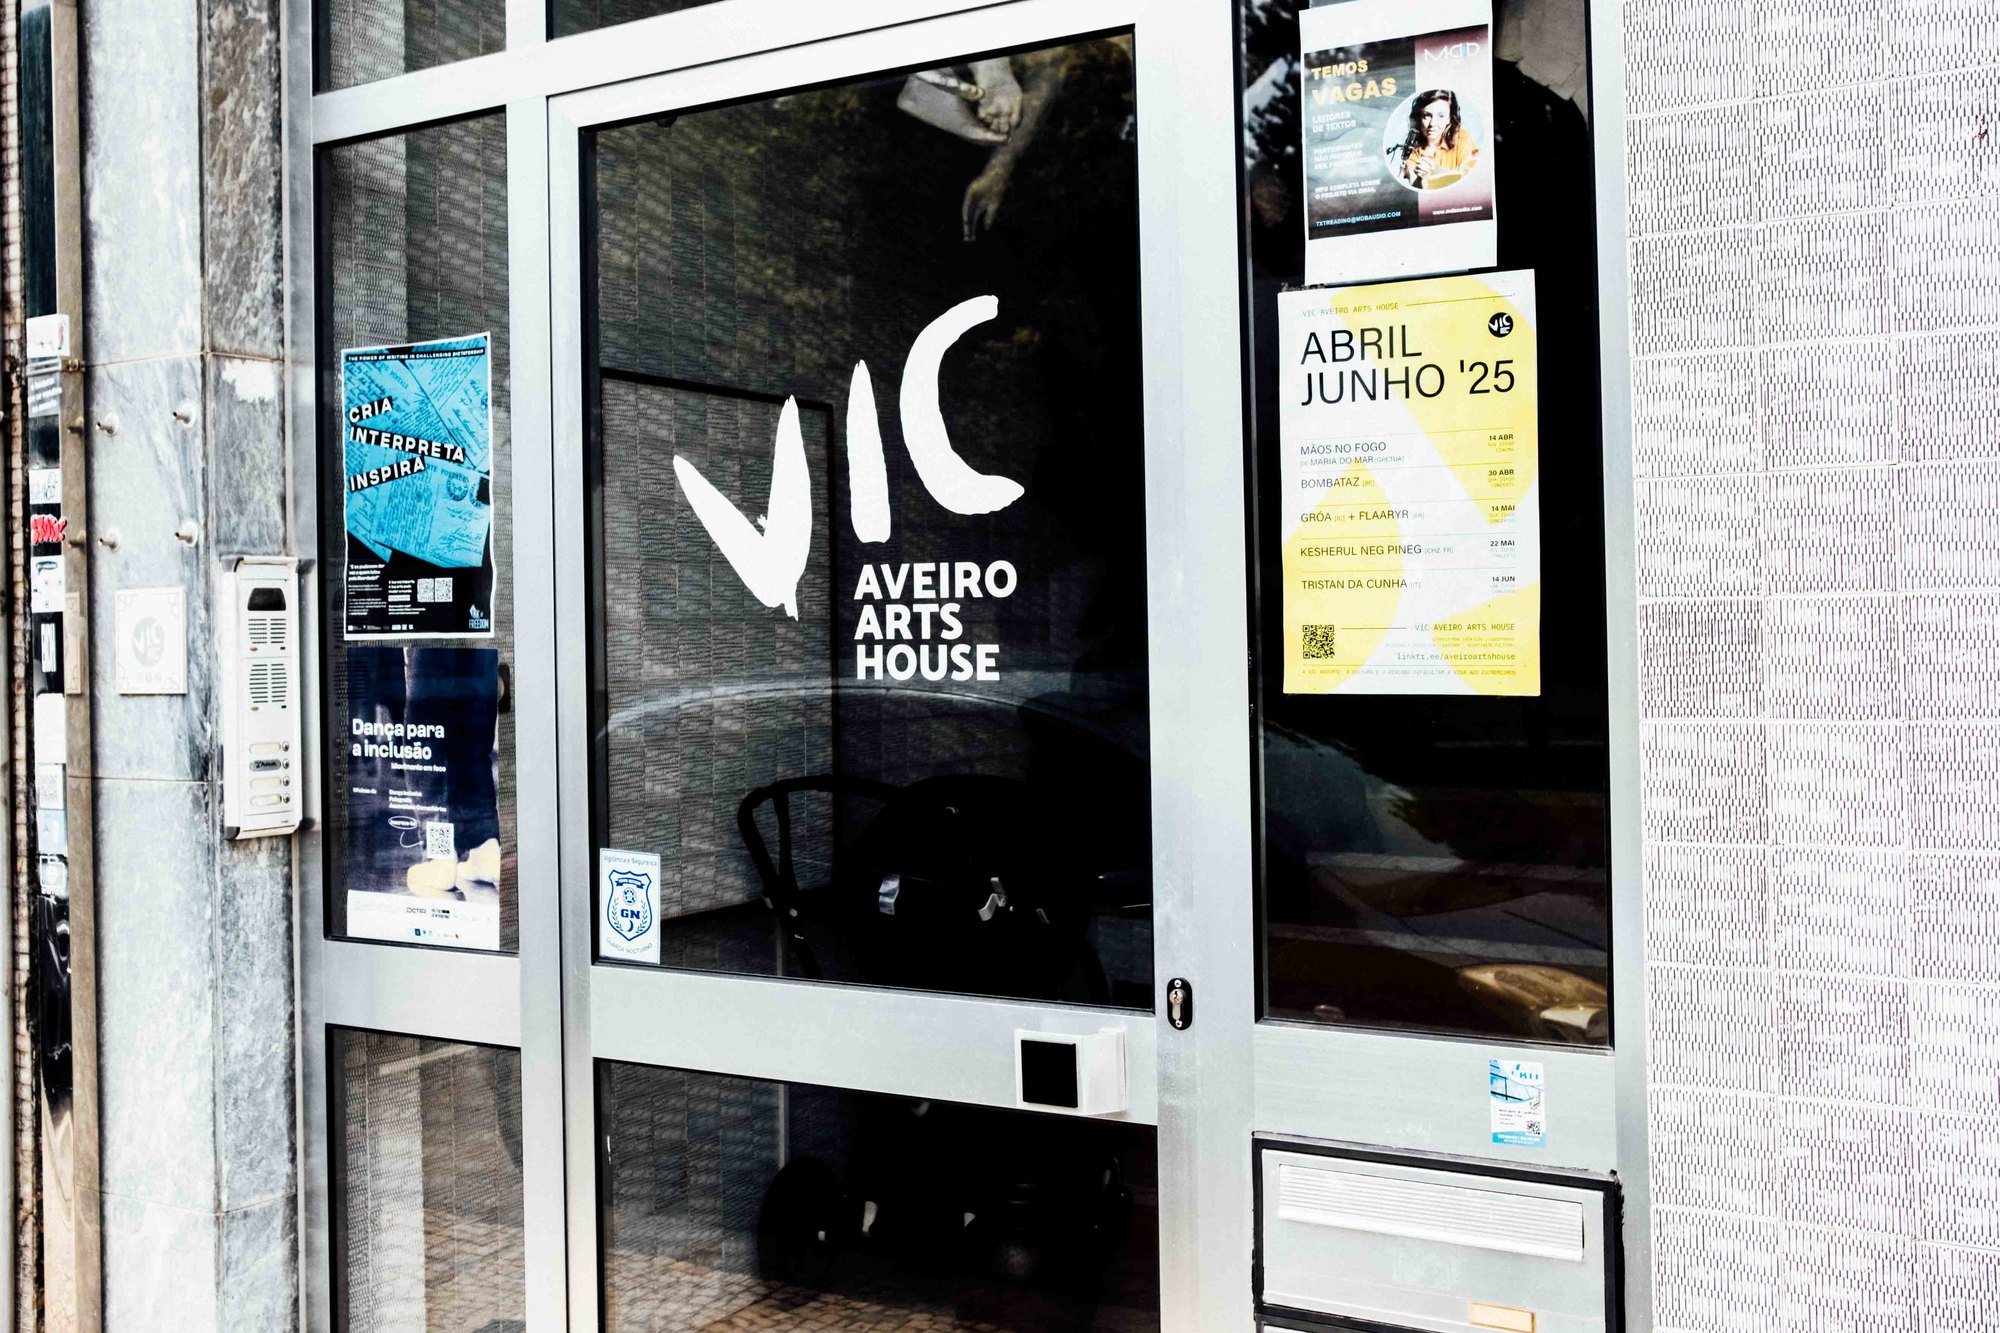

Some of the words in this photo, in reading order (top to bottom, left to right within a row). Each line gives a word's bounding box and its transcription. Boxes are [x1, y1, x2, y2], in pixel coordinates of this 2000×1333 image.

[1311, 60, 1368, 80] TEMOS
[1312, 78, 1396, 106] VAGAS
[1312, 111, 1351, 123] LEITORES
[1312, 124, 1324, 132] DE
[1326, 120, 1356, 130] TEXTOS
[1320, 306, 1349, 315] AVEIRO
[1489, 316, 1515, 336] VIC
[1301, 325, 1422, 365] ABRIL
[1302, 363, 1444, 406] JUNHO
[1460, 360, 1515, 394] '25
[349, 398, 392, 423] CRIA
[350, 426, 464, 462] INTERPRETA
[1301, 444, 1332, 455] MÃOS
[1335, 444, 1351, 453] NO
[1355, 442, 1386, 452] FOGO
[674, 294, 1024, 621] VIC
[1310, 458, 1337, 466] MARIA
[1354, 456, 1373, 464] MAR
[350, 456, 425, 491] INSPIRA
[1301, 477, 1360, 488] BOMBATAZ
[1301, 510, 1332, 522] GRÓA
[1359, 510, 1409, 520] FLAARYR
[1301, 547, 1357, 557] KESHERUL
[1361, 546, 1384, 555] NEG
[1388, 545, 1421, 554] PINEG
[854, 560, 1017, 599] AVEIRO
[1302, 580, 1344, 589] TRISTAN
[1348, 580, 1363, 589] DA
[1367, 579, 1407, 588] CUNHA
[854, 603, 963, 640] ARTS
[857, 644, 1000, 681] HOUSE
[1397, 652, 1516, 660] linktr.ee/aveiroartshouse
[352, 718, 405, 741] Dança
[407, 724, 444, 740] para
[353, 744, 361, 756] a
[364, 739, 432, 760] inclusão
[391, 763, 422, 771] Movimento
[423, 764, 432, 772] em
[621, 909, 640, 919] GN
